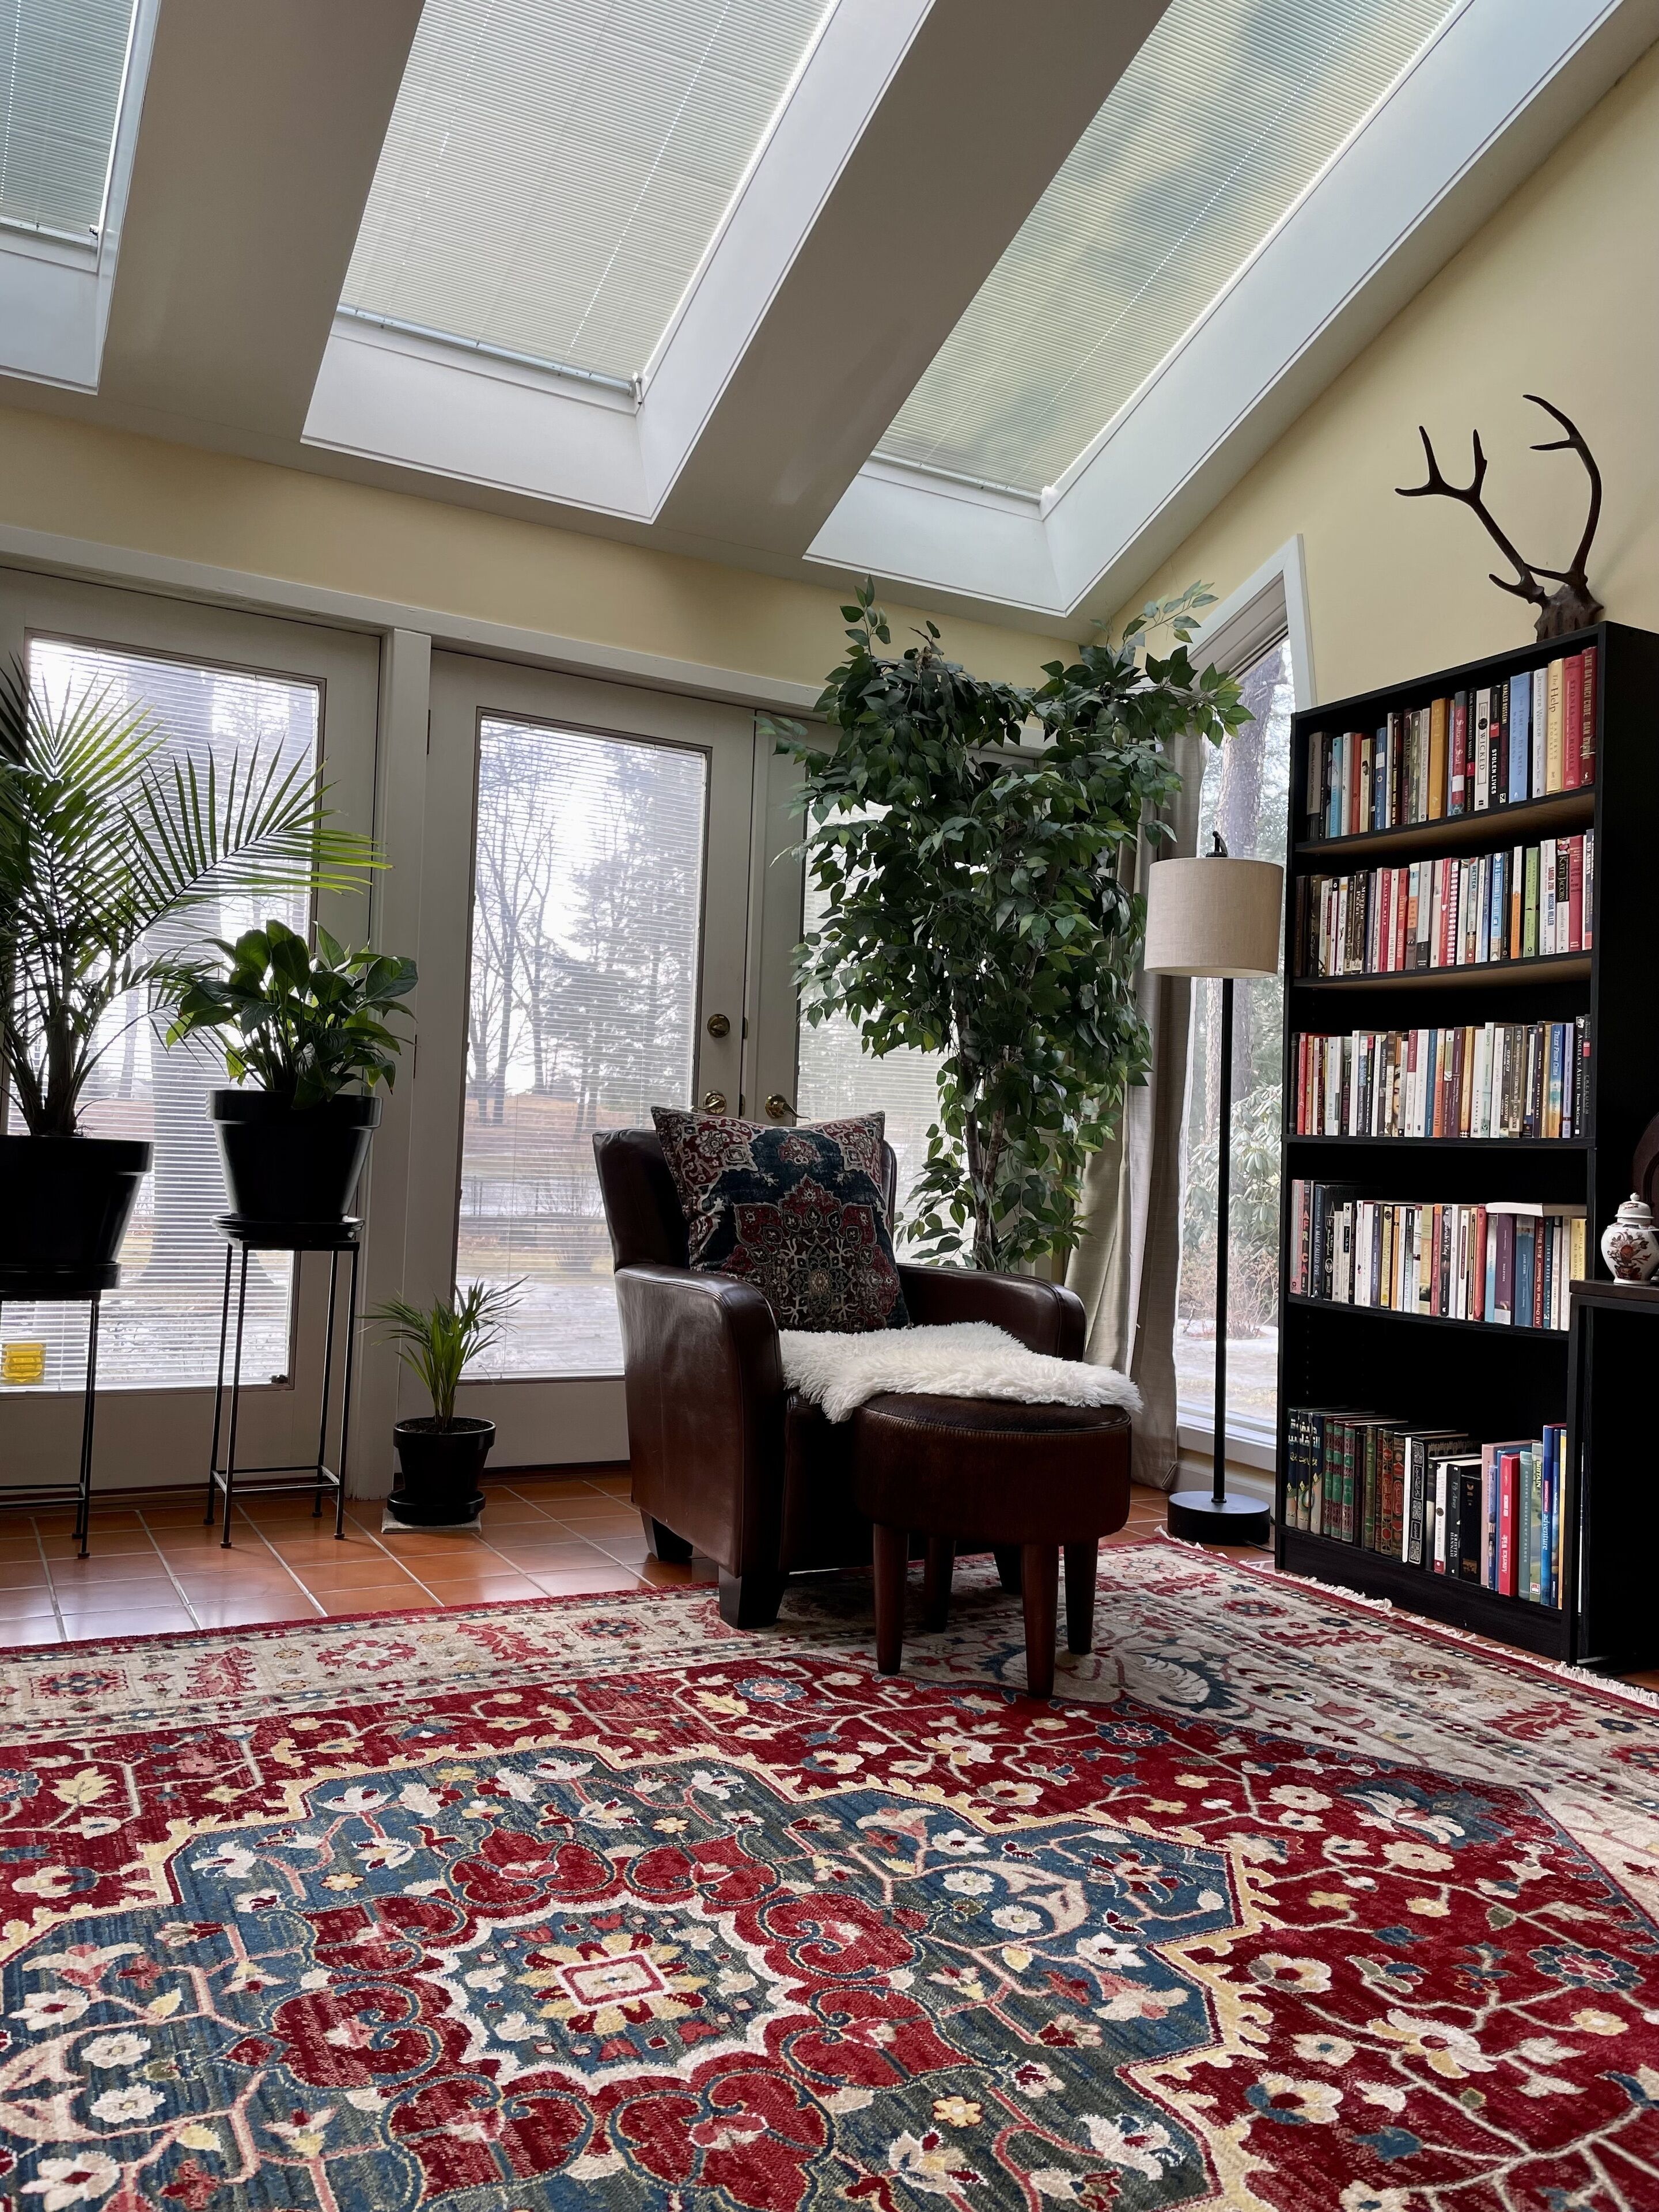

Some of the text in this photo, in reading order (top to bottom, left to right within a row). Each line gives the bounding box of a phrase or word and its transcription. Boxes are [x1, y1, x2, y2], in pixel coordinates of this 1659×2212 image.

[1548, 687, 1559, 713] Help
[1584, 654, 1592, 716] THE DA VINCI CODE
[1455, 748, 1463, 764] Seal
[1582, 721, 1591, 759] DAN BROWN
[1558, 855, 1567, 901] KATE JACOBS
